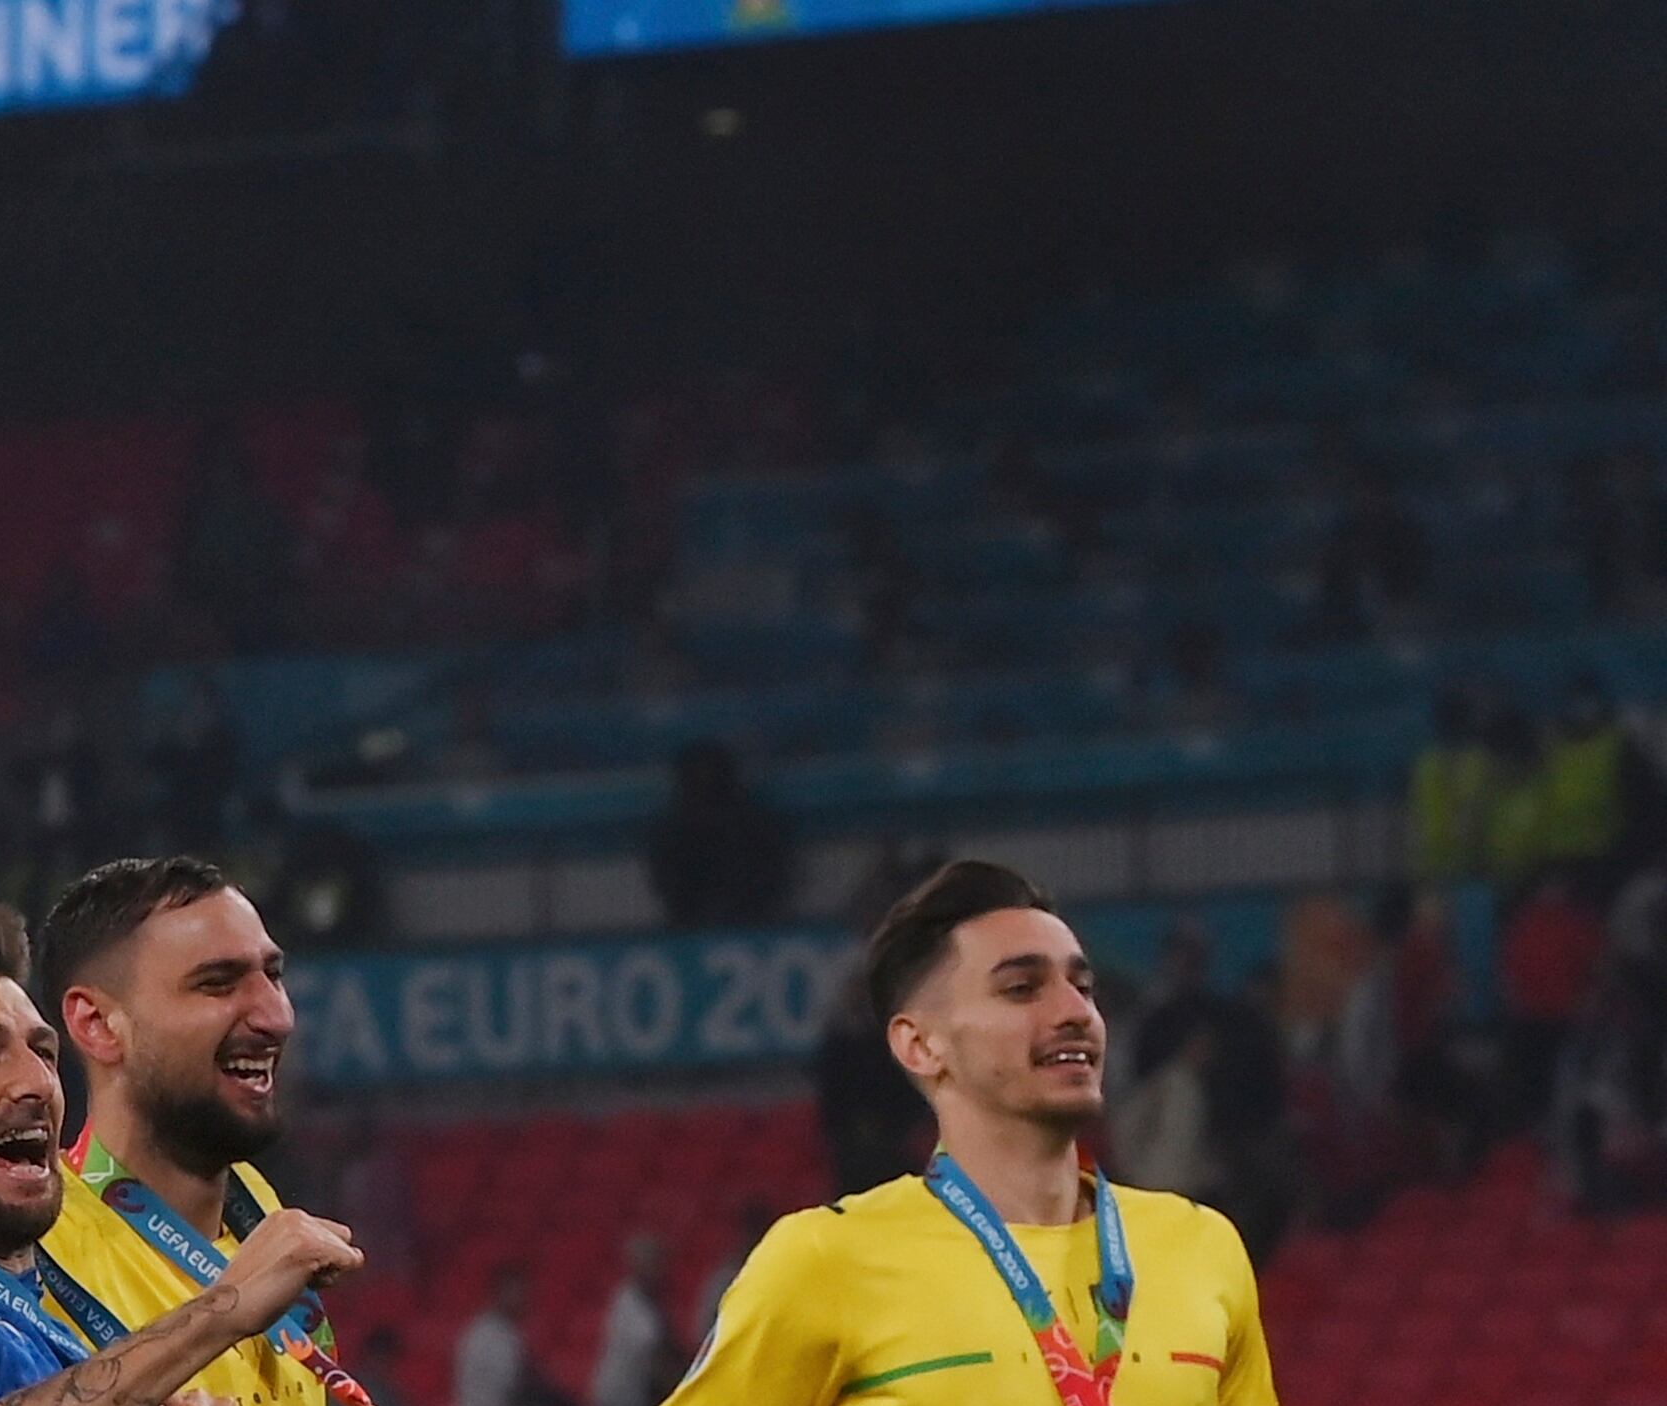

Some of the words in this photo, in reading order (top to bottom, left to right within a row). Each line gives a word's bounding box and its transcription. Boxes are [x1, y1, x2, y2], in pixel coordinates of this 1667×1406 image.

[401, 948, 682, 1068] EURO
[147, 1213, 190, 1258] UEFA
[187, 1250, 224, 1281] EUR
[942, 1180, 975, 1216] UEFA
[970, 1211, 1005, 1250] EURO
[997, 1250, 1030, 1291] 2020
[86, 1306, 121, 1342] EFA
